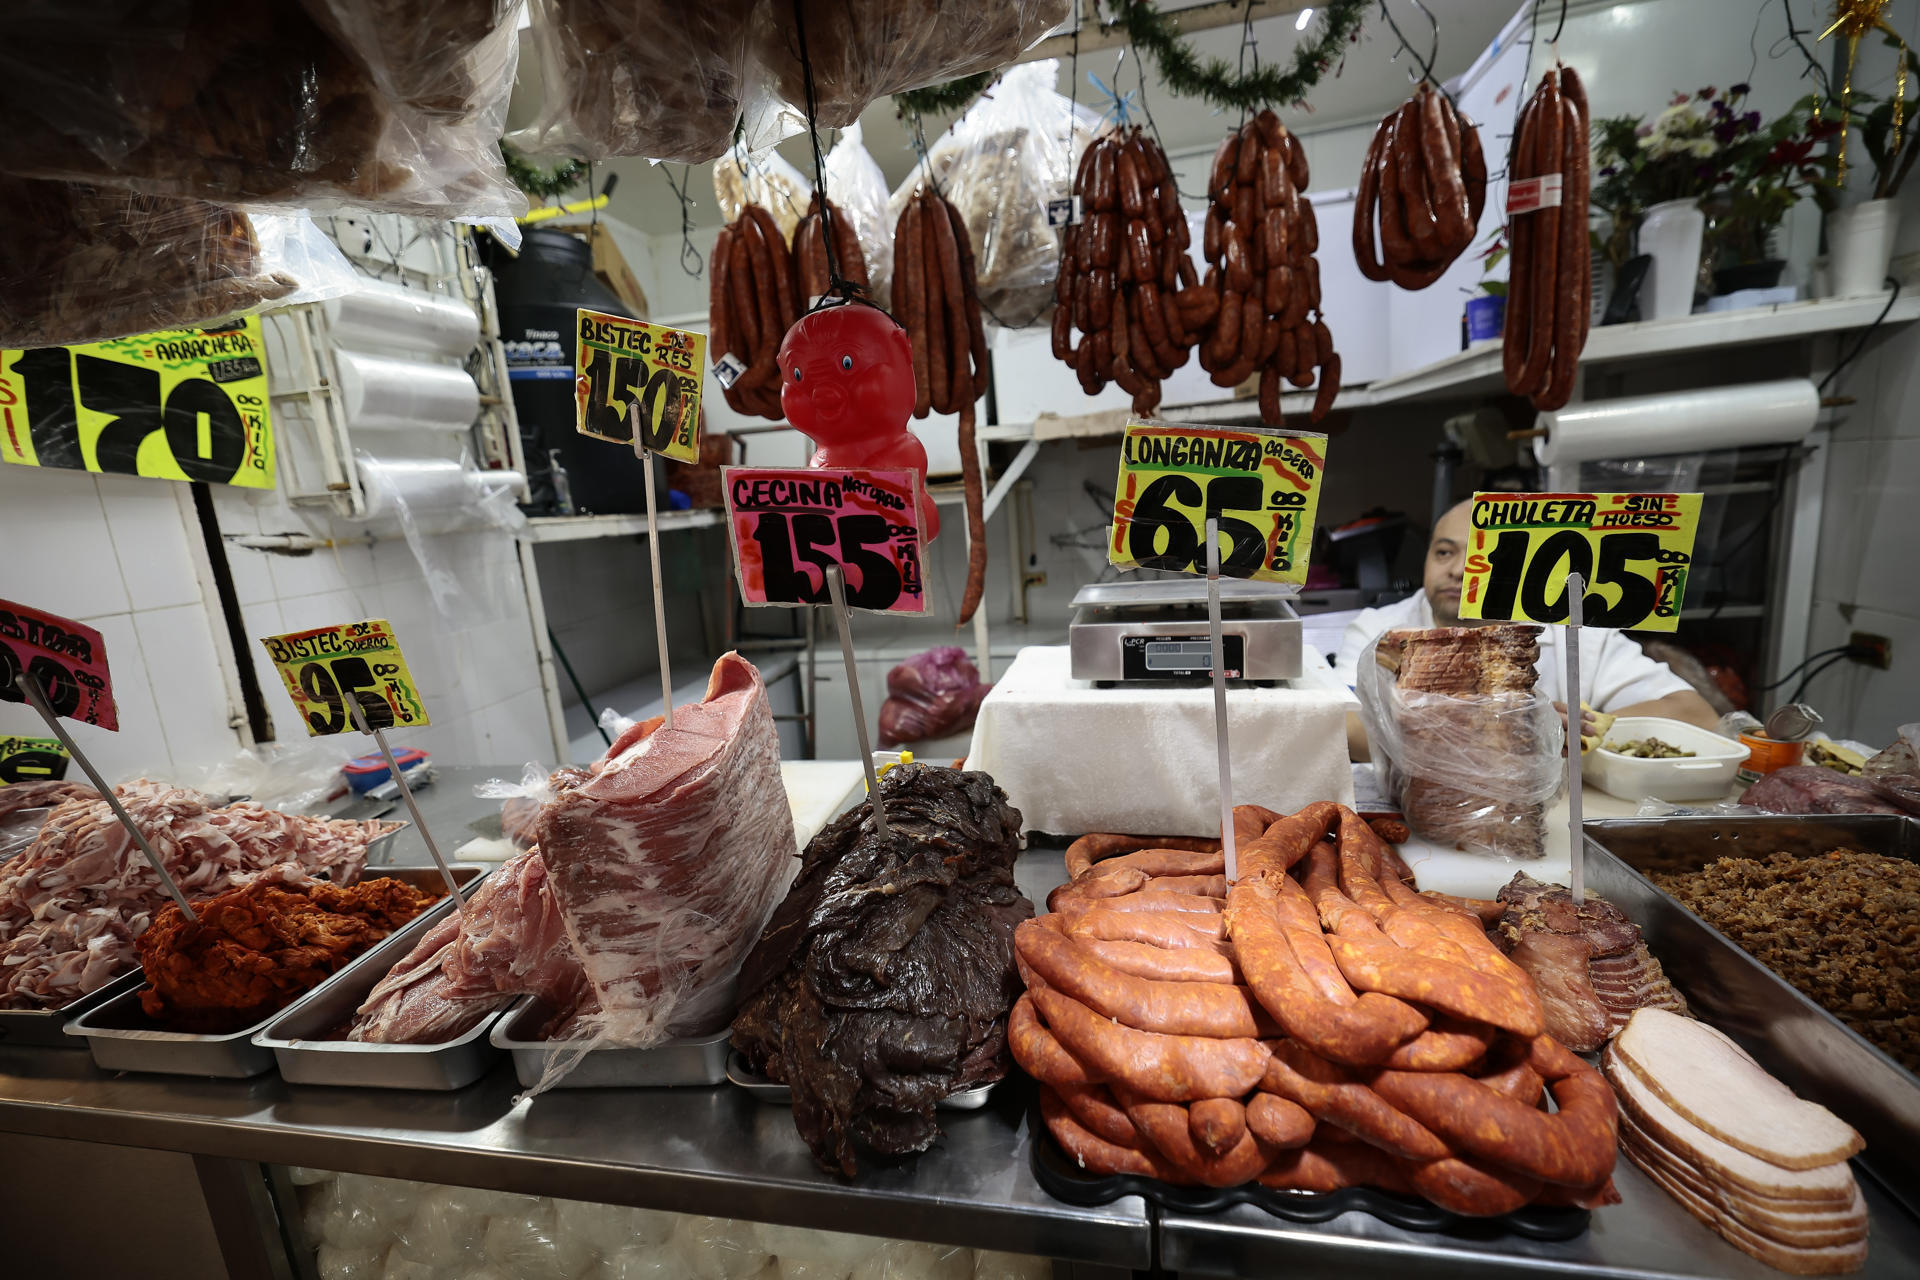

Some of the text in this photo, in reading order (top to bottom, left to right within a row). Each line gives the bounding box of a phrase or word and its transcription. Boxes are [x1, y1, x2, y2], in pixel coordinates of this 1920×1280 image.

[156, 335, 253, 361] ARRACHERA
[580, 317, 652, 354] BISTEC
[655, 346, 692, 369] RES
[677, 376, 698, 390] 00
[236, 393, 263, 406] 00
[585, 349, 681, 451] 150
[10, 347, 247, 484] 170
[678, 394, 697, 446] KILO
[249, 413, 266, 470] KILO
[1124, 436, 1314, 480] LONGANIZA CASERA
[733, 479, 843, 508] CECINA
[1271, 490, 1306, 505] 00
[1625, 496, 1664, 512] SIN
[887, 524, 918, 536] 00
[1129, 475, 1266, 579] 65
[1472, 500, 1596, 529] CHULETA
[1602, 513, 1673, 527] HUESO
[1270, 513, 1293, 571] KILO
[1654, 549, 1690, 563] 00
[753, 513, 902, 610] 155
[897, 543, 923, 594] KILO
[1481, 530, 1659, 628] 105
[1655, 569, 1680, 617] KILO
[352, 622, 371, 636] DE
[271, 632, 342, 663] BISTEC
[343, 637, 388, 653] PUERCO
[373, 664, 399, 676] 00
[300, 657, 394, 736] 95
[389, 679, 413, 722] KILO
